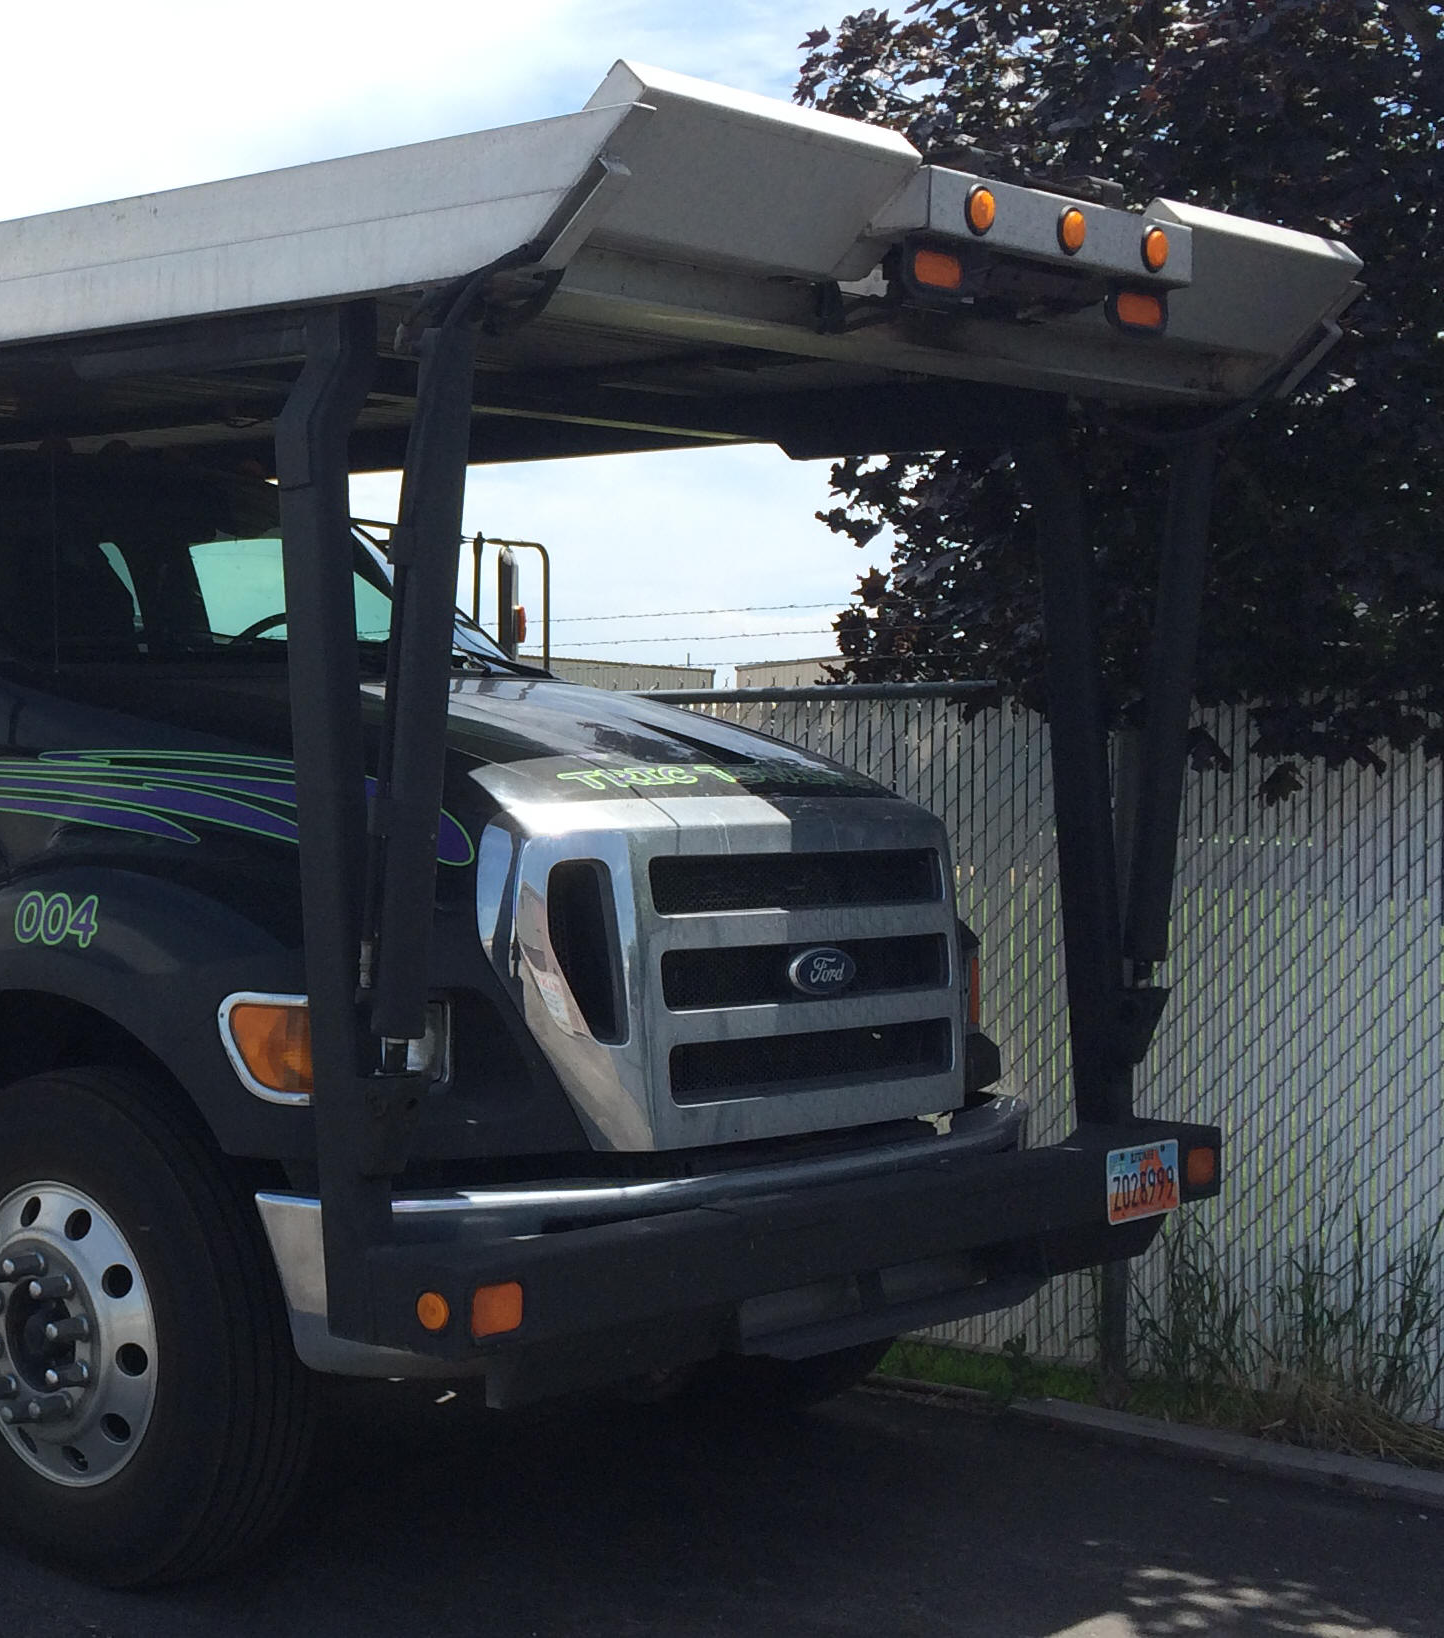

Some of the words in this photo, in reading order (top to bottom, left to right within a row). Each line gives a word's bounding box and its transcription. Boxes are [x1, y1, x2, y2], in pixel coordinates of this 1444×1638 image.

[557, 766, 698, 790] TRIC
[15, 891, 99, 948] 004
[810, 957, 845, 984] Ford
